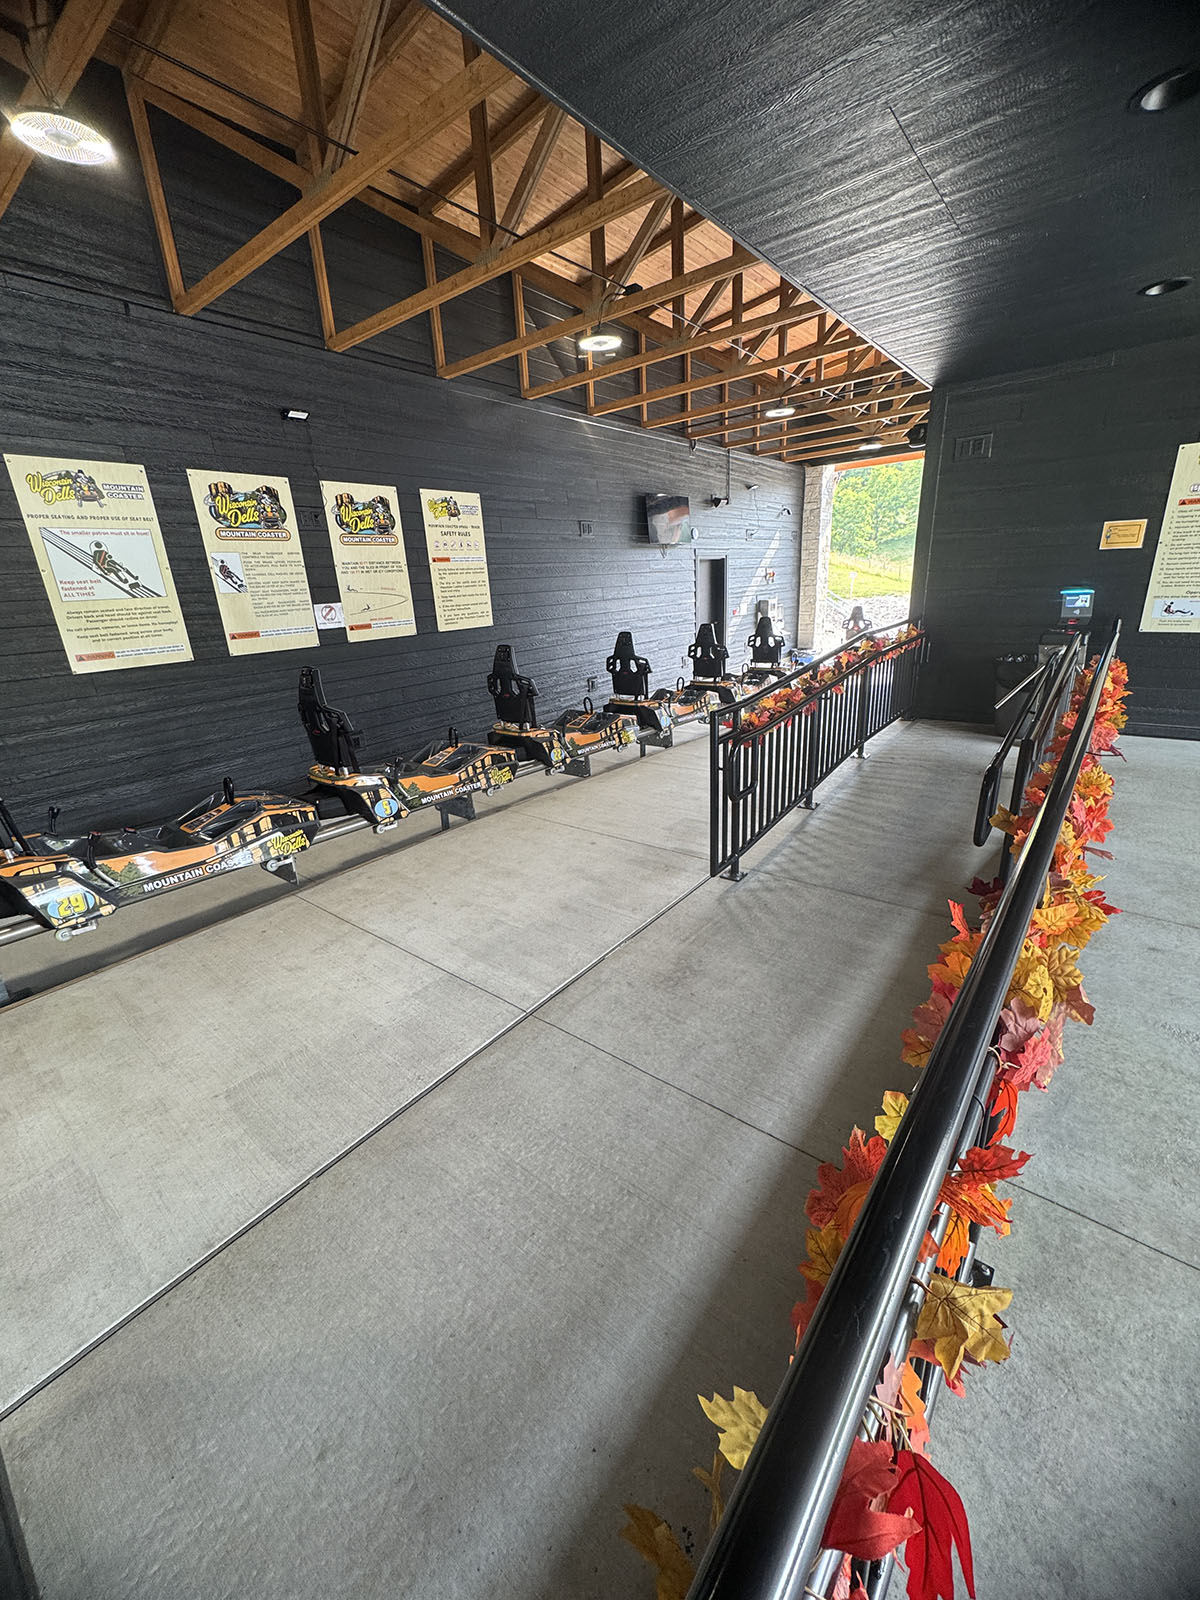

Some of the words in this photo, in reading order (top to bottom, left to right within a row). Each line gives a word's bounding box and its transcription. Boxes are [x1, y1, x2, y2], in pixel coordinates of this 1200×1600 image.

[25, 472, 73, 493] Wisconsin
[102, 484, 144, 493] MOUNTAIN
[40, 486, 76, 505] Dells
[107, 492, 144, 500] COASTER
[216, 494, 258, 515] Wisconsin
[227, 507, 260, 527] Dells
[350, 516, 374, 534] Dells
[420, 790, 454, 804] MOUNTAIN
[454, 782, 481, 794] COASTER
[281, 836, 306, 856] Dells
[143, 866, 204, 893] MOUNTAIN
[205, 853, 254, 874] COASTER
[56, 892, 88, 918] 29
